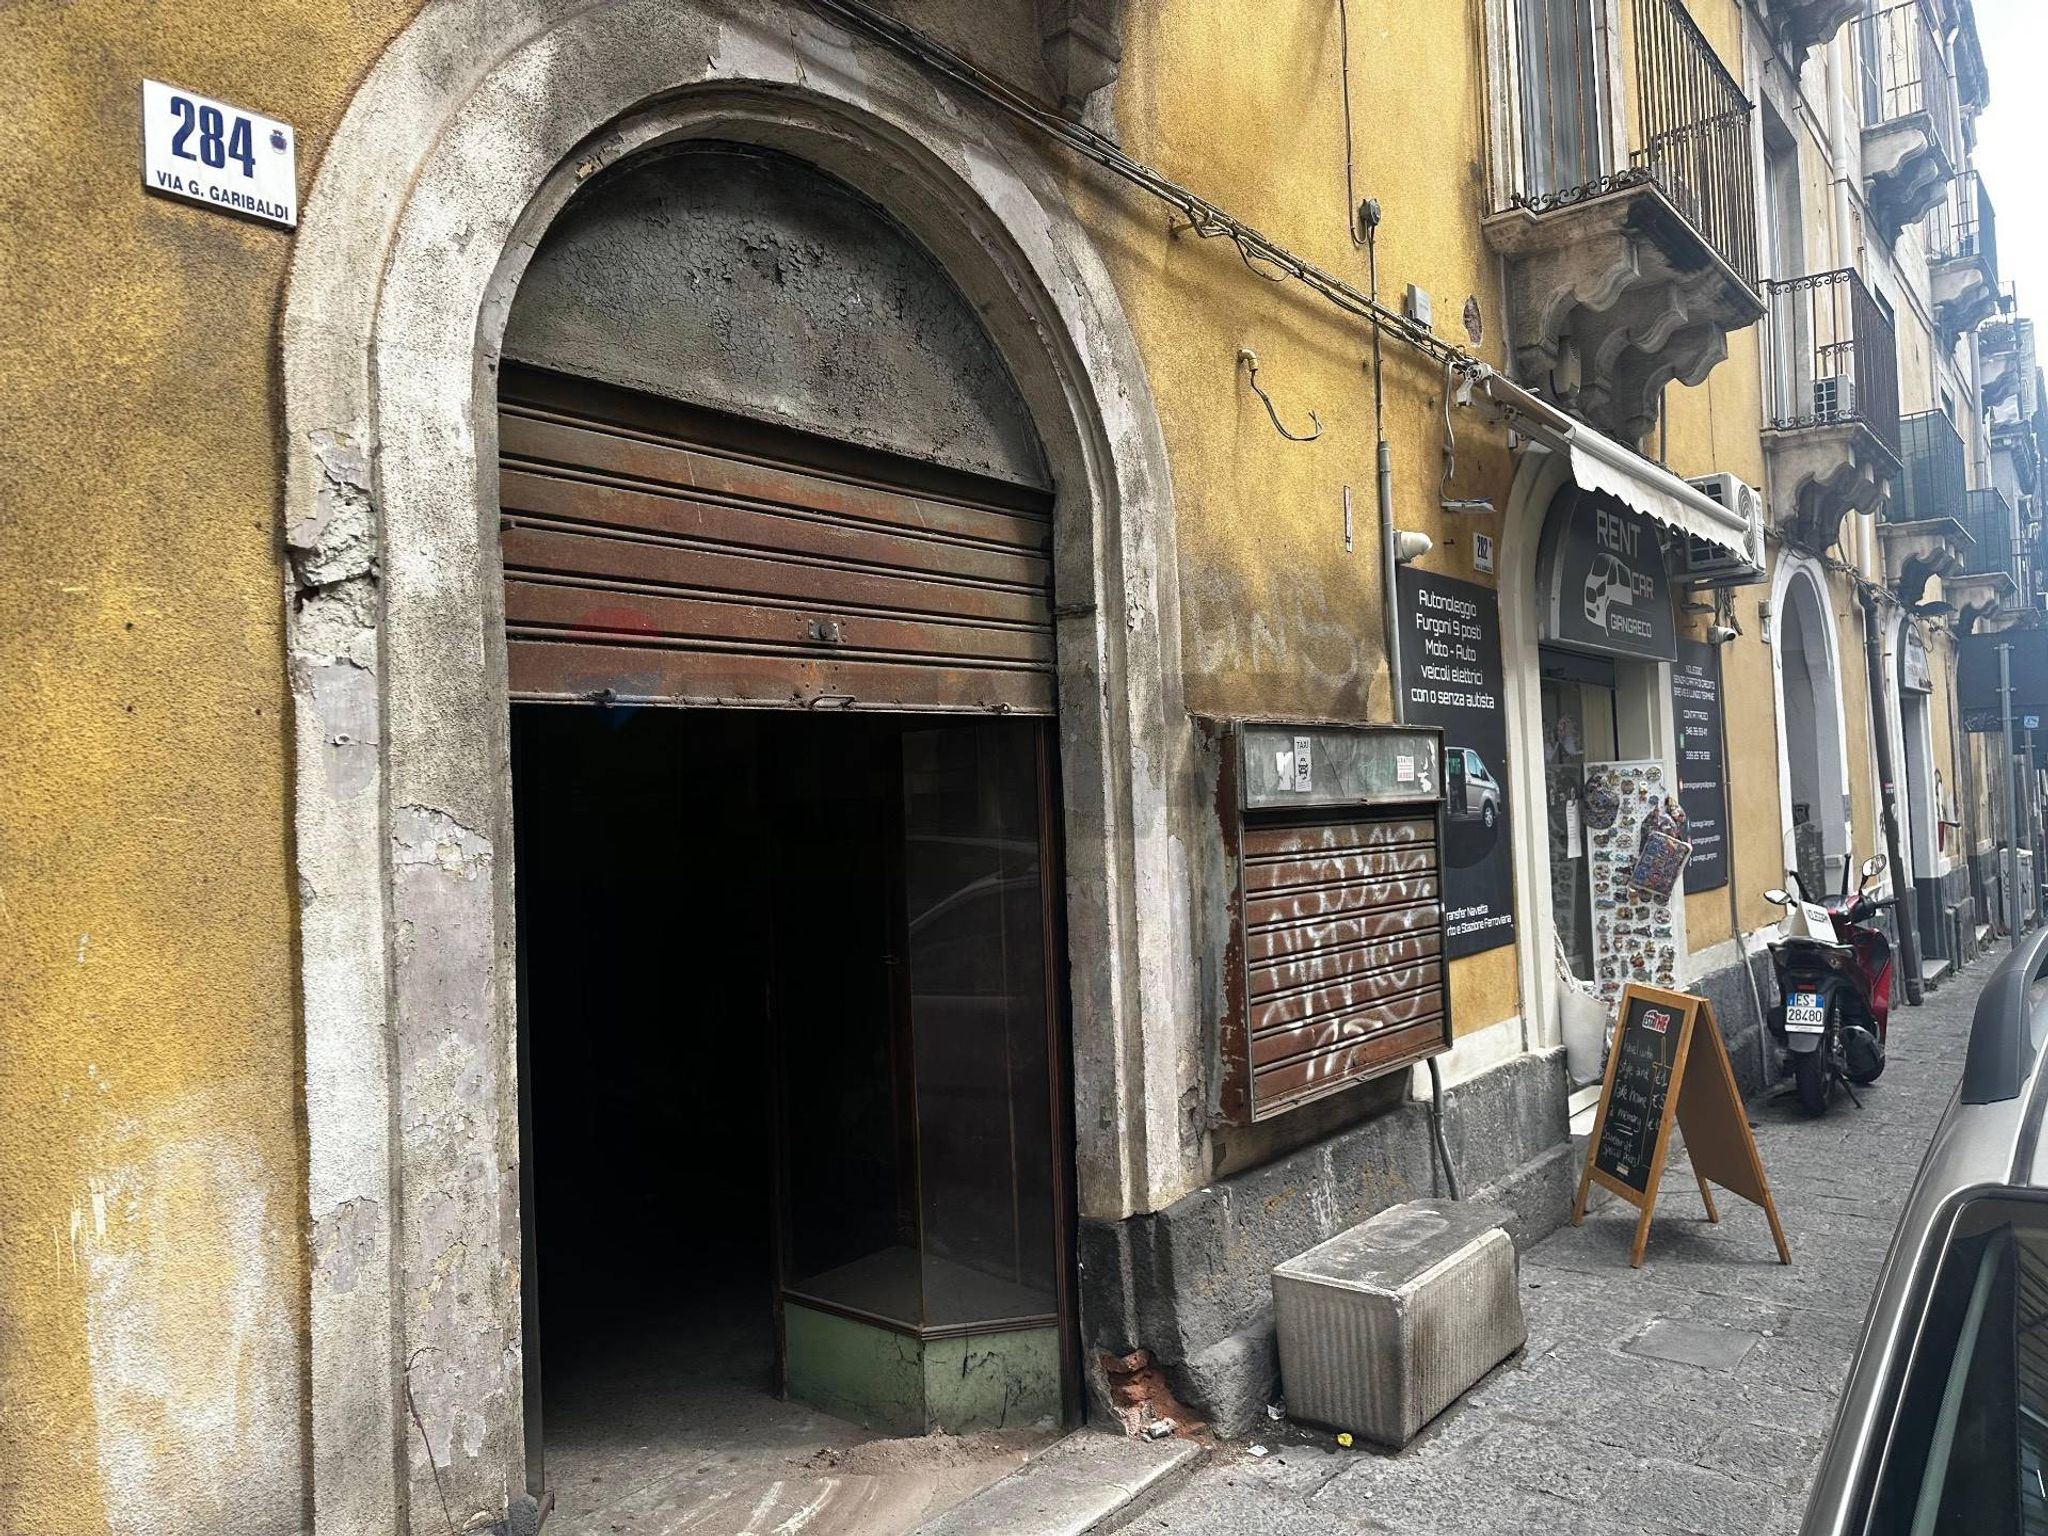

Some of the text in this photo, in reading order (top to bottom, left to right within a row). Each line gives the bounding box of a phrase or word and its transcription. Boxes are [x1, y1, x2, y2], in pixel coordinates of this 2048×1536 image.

[170, 96, 256, 179] 284
[156, 170, 289, 221] VIA G. GARIBALDI
[1596, 509, 1641, 558] RENT
[1631, 571, 1654, 600] CAR
[1418, 589, 1477, 620] Autonoleggio
[1416, 612, 1482, 641] Furgoni 9 posti
[1425, 638, 1449, 658] Moto
[1456, 644, 1476, 662] Auto
[1420, 662, 1483, 685] veicoli elettrici
[1411, 687, 1495, 709] con o senza autista
[1446, 907, 1467, 921] ransfer
[1788, 1009, 1822, 1022] 28480
